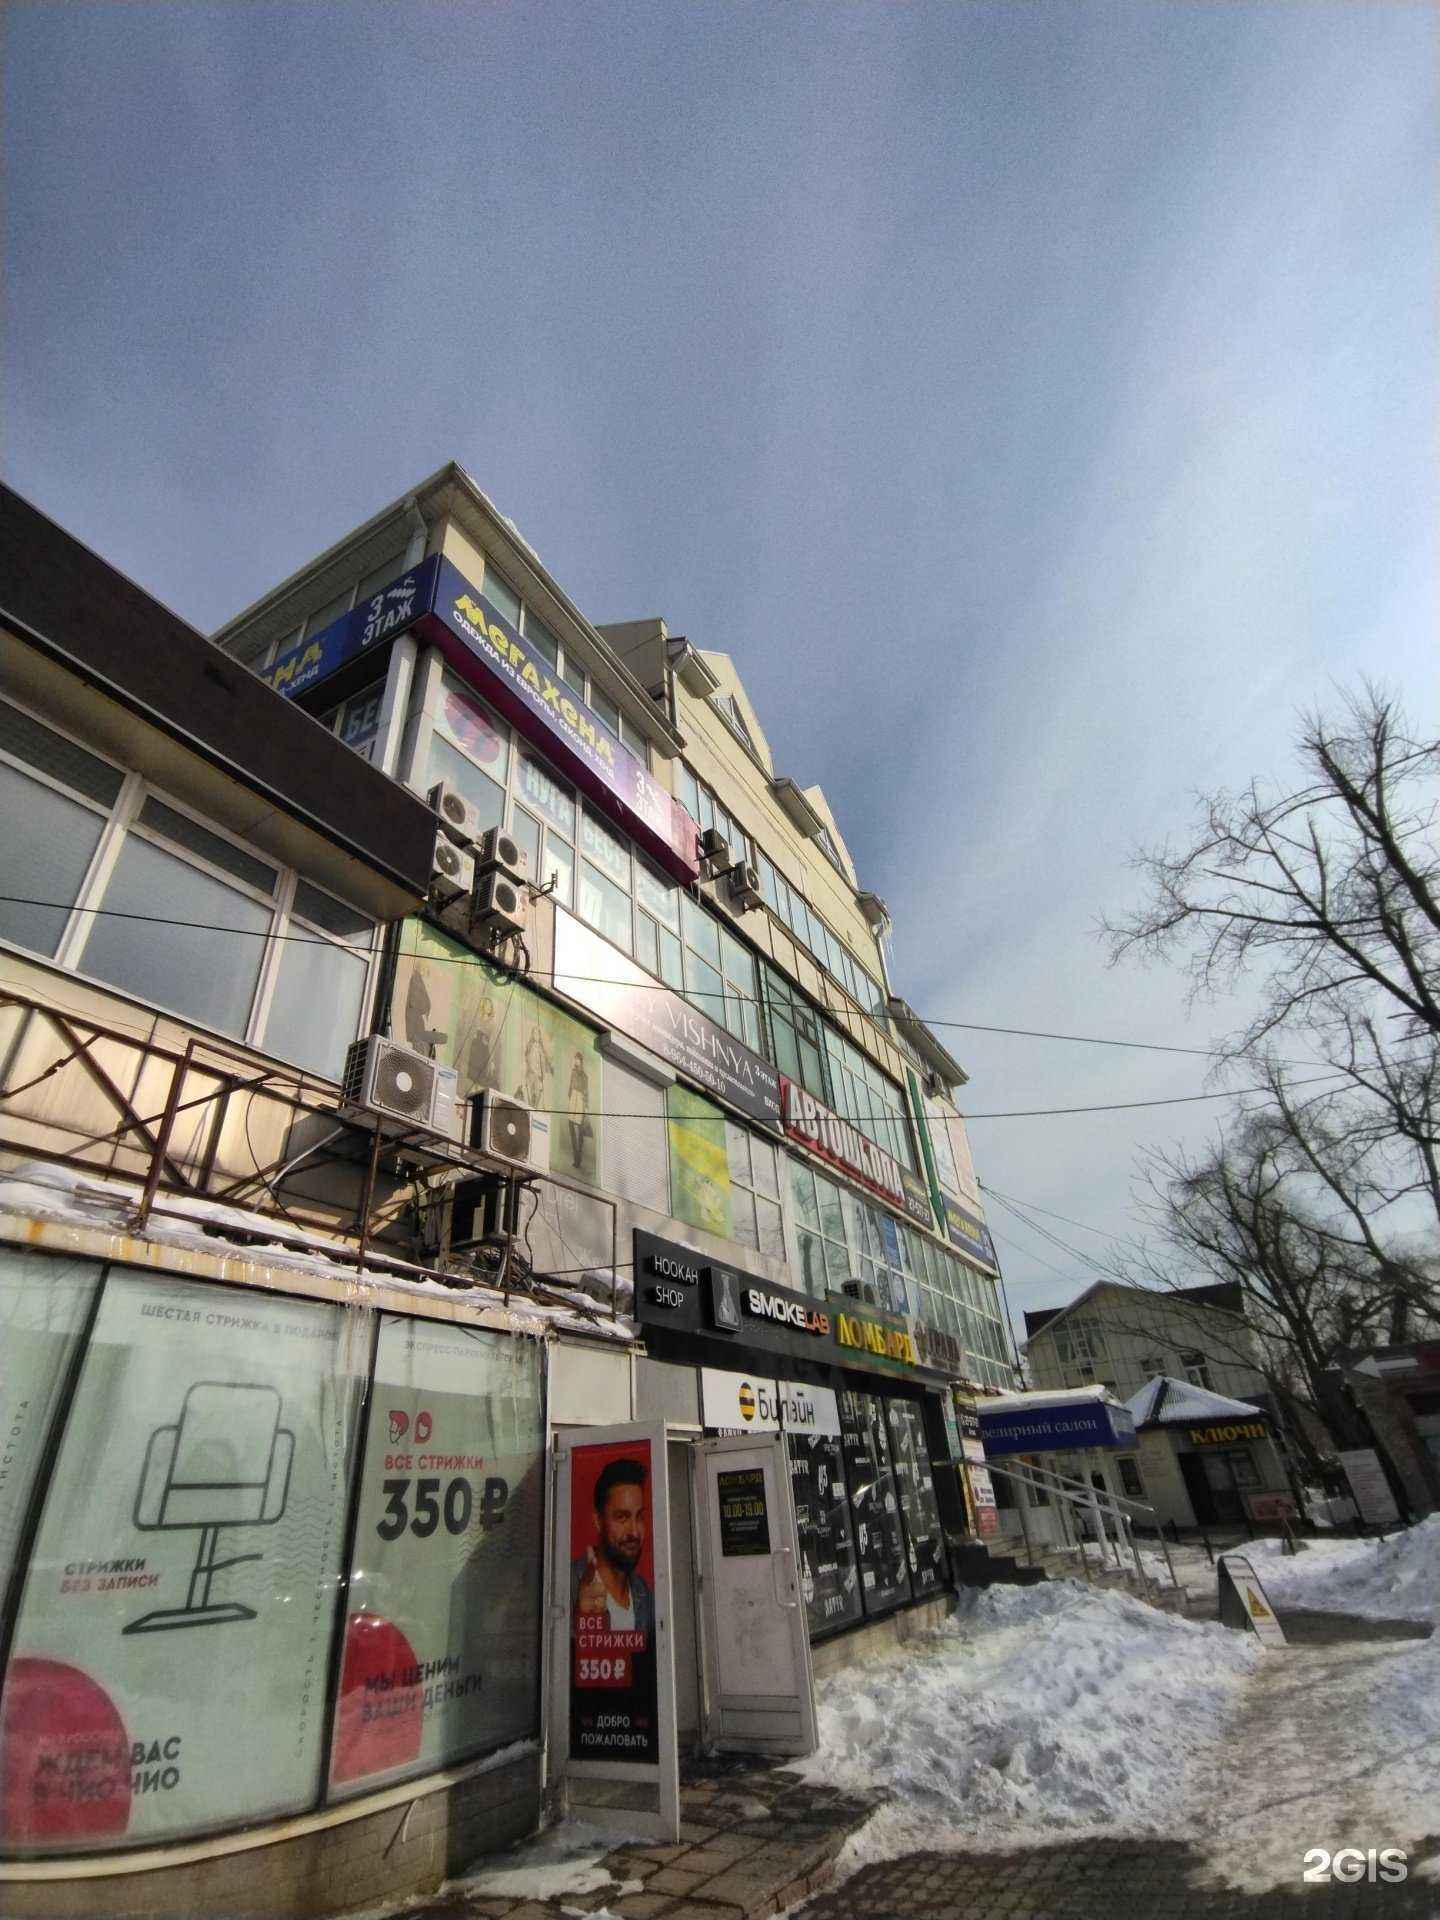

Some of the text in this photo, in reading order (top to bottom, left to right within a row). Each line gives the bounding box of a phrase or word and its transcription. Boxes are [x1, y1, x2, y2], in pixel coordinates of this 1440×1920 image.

[361, 598, 414, 646] ЭТАЖ
[453, 610, 500, 663] ОДЕЖДА
[664, 1001, 754, 1085] VISHNYA
[790, 1083, 905, 1204] АВТОШКОЛА
[654, 1255, 698, 1285] HOOKAH
[656, 1286, 684, 1308] SHOP
[141, 1304, 201, 1323] ШЕСТАЯ
[205, 1313, 269, 1331] СТРИЖКА
[838, 1312, 916, 1365] ЛОМБАРД
[1055, 1419, 1097, 1433] салон
[1190, 1424, 1266, 1443] КЛЮЧИ
[0, 1401, 28, 1488] ИСТОТА
[385, 1456, 484, 1470] ВСЕ СТРИЖКИ
[64, 1558, 146, 1575] СТРИЖКИ
[98, 1574, 159, 1591] ЗАПИСИ
[579, 1617, 602, 1630] ВСЕ
[579, 1634, 644, 1649] СТРИЖКИ
[424, 1674, 482, 1710] ДЕНЬГИ
[597, 1715, 631, 1728] ДОБРО
[131, 1737, 181, 1767] ВАС
[581, 1733, 648, 1748] ПОЖАЛОВАТЬ
